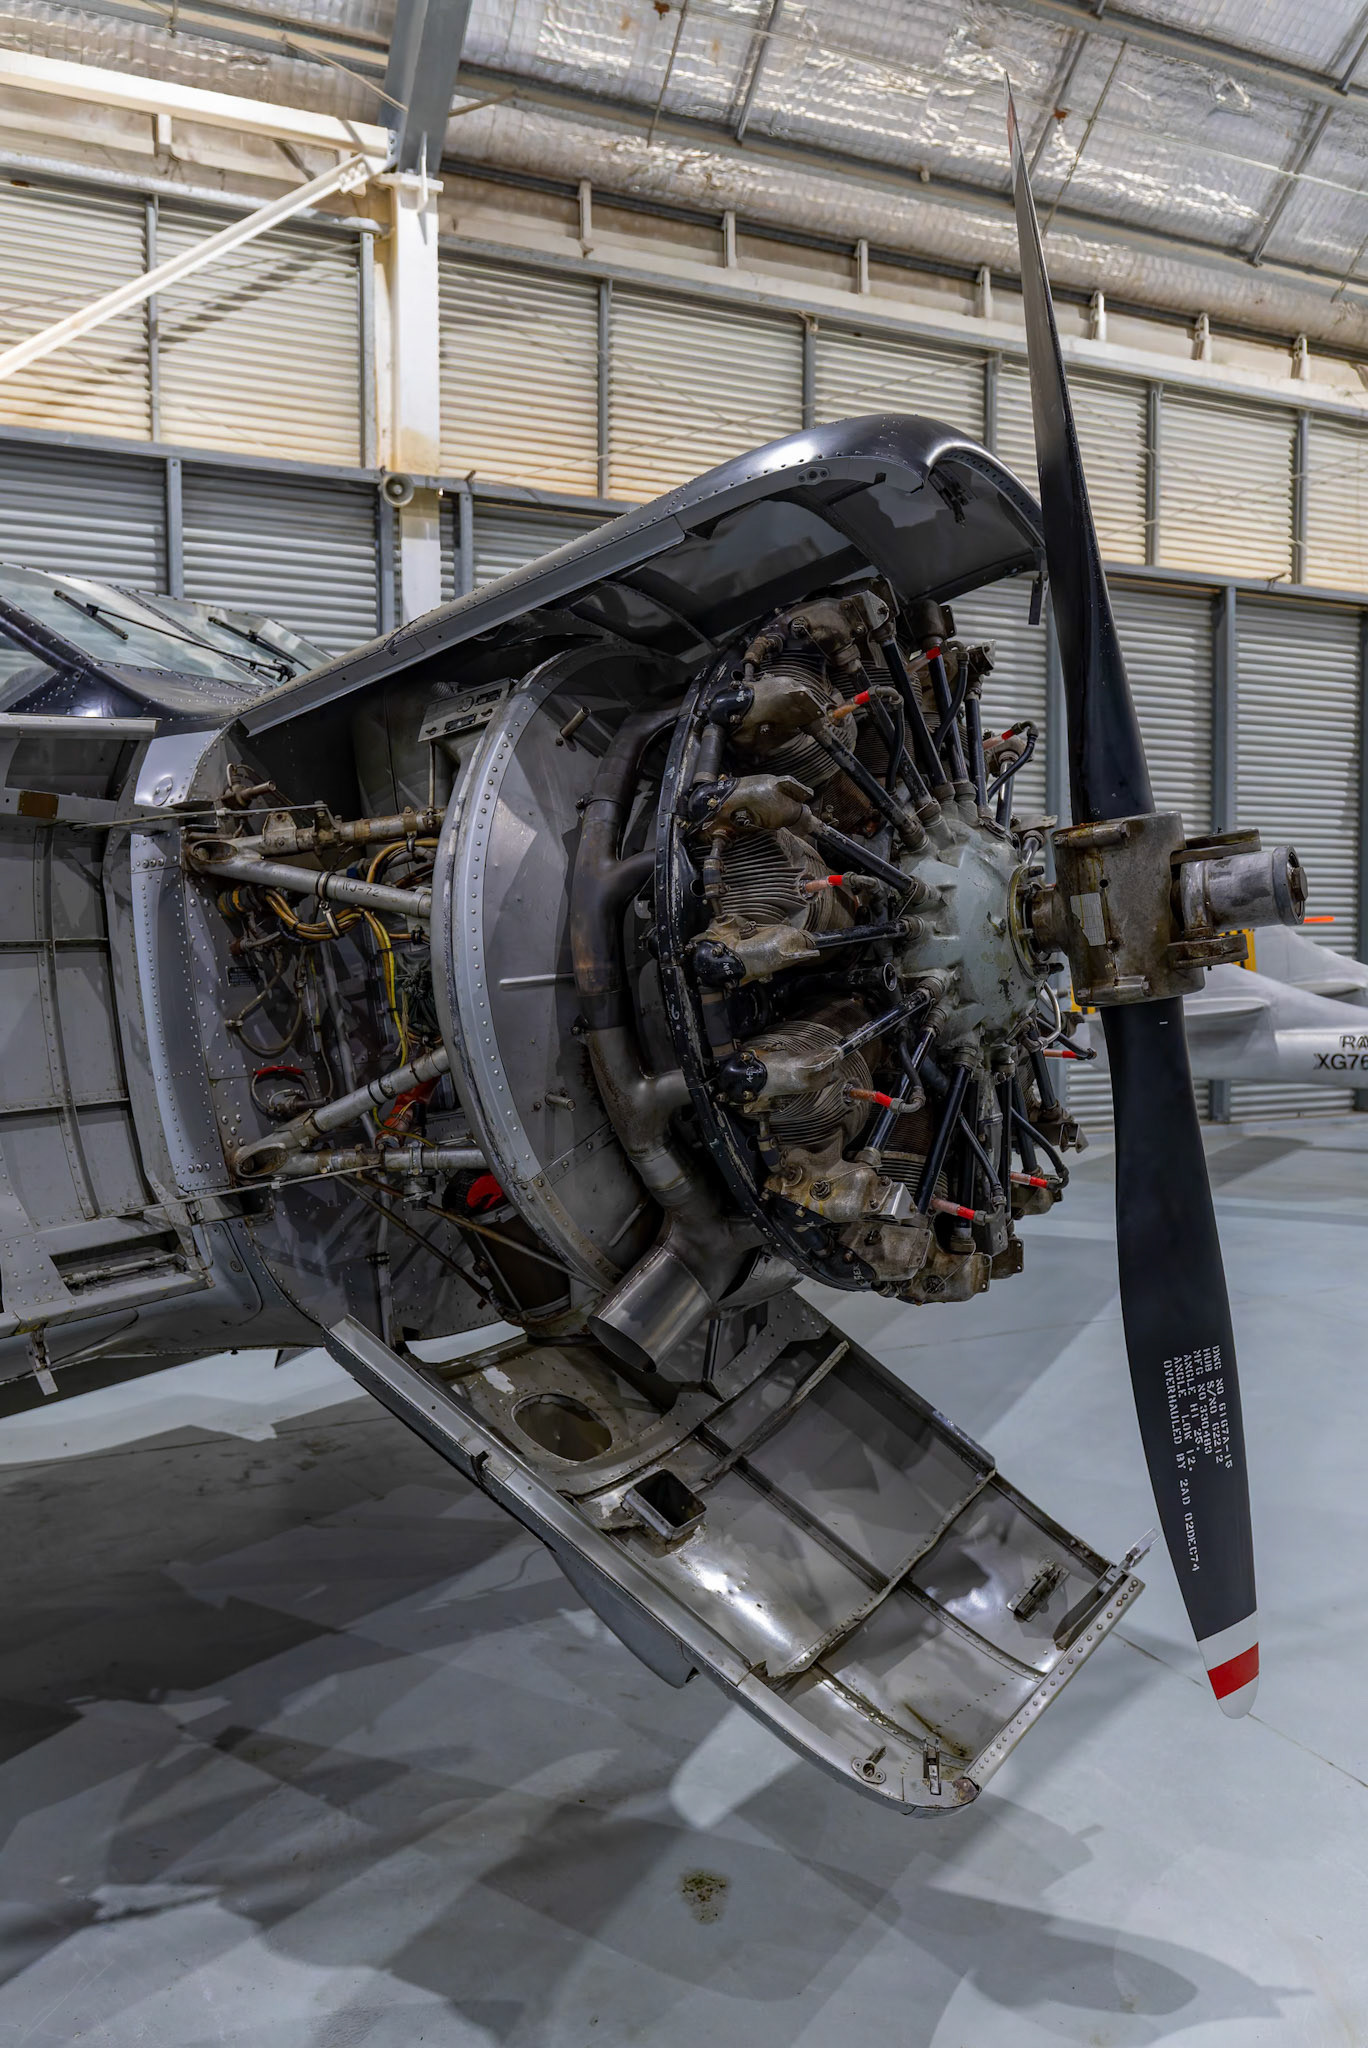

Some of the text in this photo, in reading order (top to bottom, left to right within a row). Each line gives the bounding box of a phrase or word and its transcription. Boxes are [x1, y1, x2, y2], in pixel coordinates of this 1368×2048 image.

[1318, 1053, 1368, 1070] XG76
[1192, 1349, 1204, 1376] MFG
[1202, 1347, 1213, 1373] HUB
[1183, 1354, 1197, 1396] ANGLE
[1215, 1377, 1225, 1395] NO
[1163, 1360, 1183, 1445] OVERHAULED
[1173, 1357, 1187, 1398] ANGLE
[1181, 1414, 1193, 1440] LOW
[1197, 1383, 1207, 1401] NO
[1206, 1380, 1218, 1414] S/NO
[1189, 1403, 1200, 1419] HI
[1175, 1452, 1187, 1469] BY
[1179, 1478, 1191, 1506] 2AD
